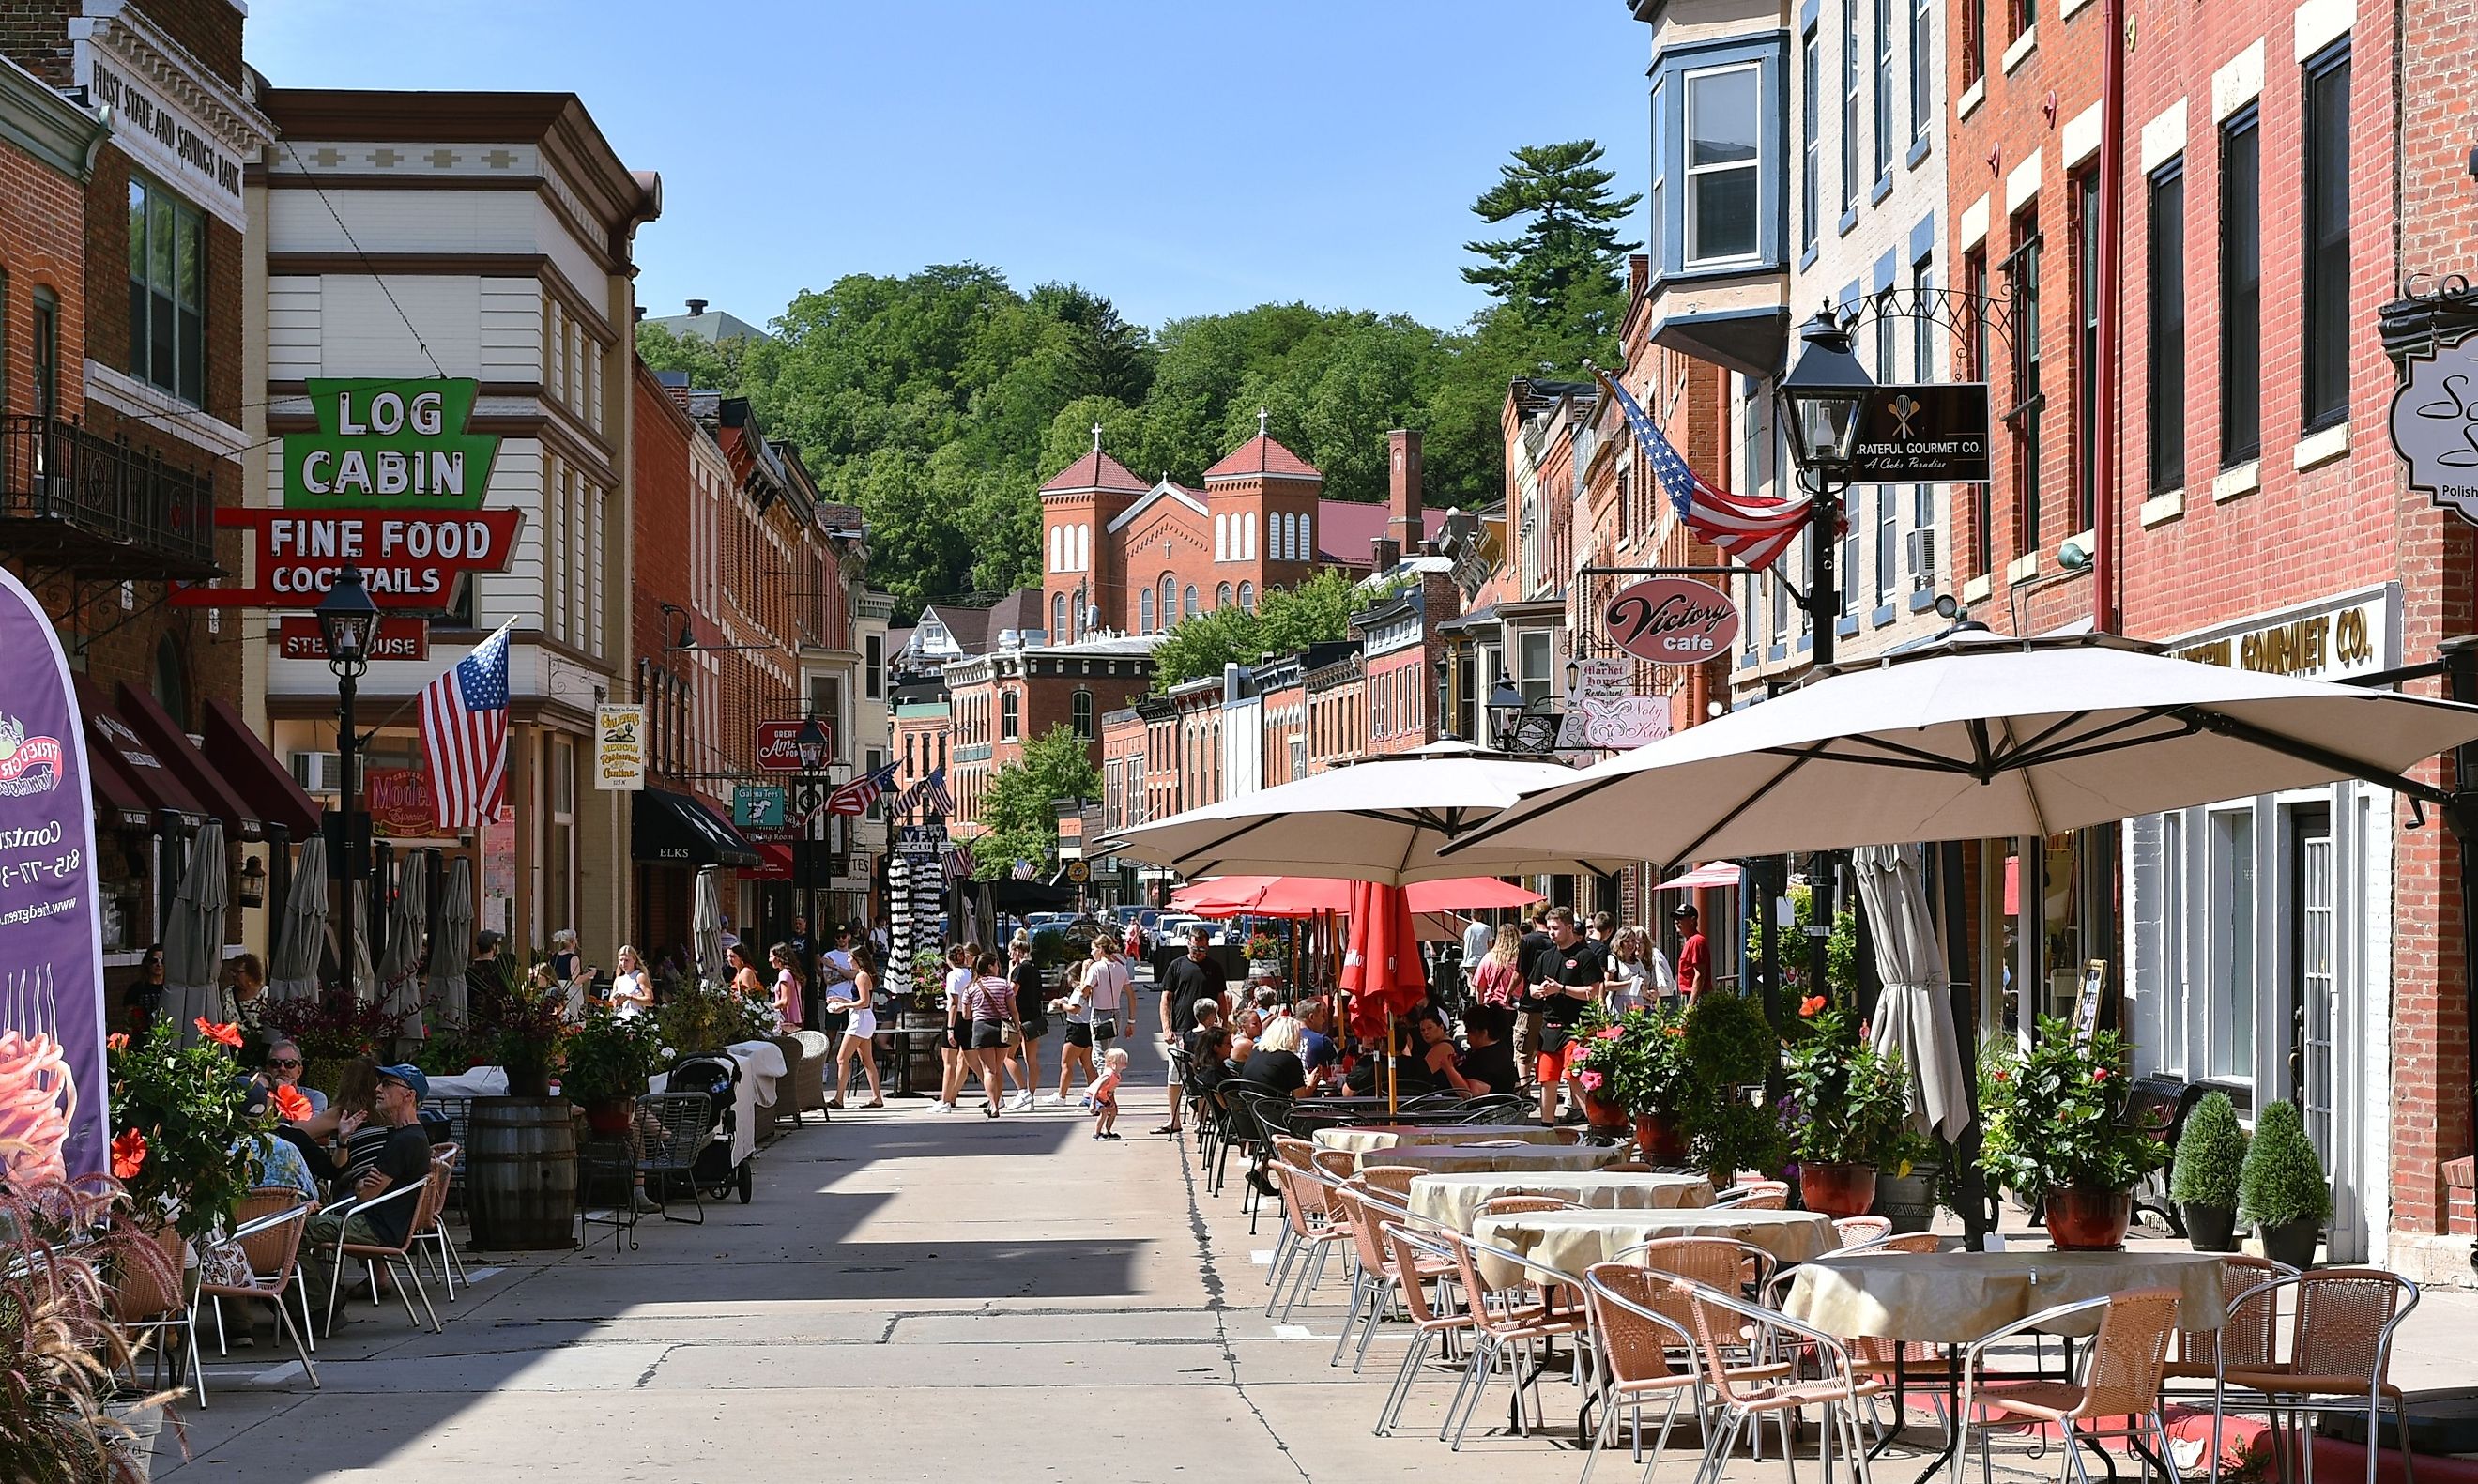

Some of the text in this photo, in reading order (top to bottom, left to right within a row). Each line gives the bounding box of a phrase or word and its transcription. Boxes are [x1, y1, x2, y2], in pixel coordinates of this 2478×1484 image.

[94, 60, 240, 198] FIRST STATE AND SAVINGS BANK
[339, 392, 442, 436] LOG
[1906, 441, 1959, 453] GOURMET
[1962, 441, 1981, 453] CO.
[303, 451, 464, 495] CABIN
[1880, 458, 1904, 469] Cooks
[1907, 457, 1947, 468] Paradise
[271, 520, 490, 558] FINE FOOD
[272, 567, 440, 593] COCTAILS
[1608, 594, 1736, 646] Victory
[1663, 634, 1714, 651] cafe
[2336, 607, 2373, 662] CO.
[1583, 665, 1623, 676] Market
[603, 744, 638, 753] MEXICAN
[764, 789, 779, 798] Tees
[660, 849, 689, 858] ELKS
